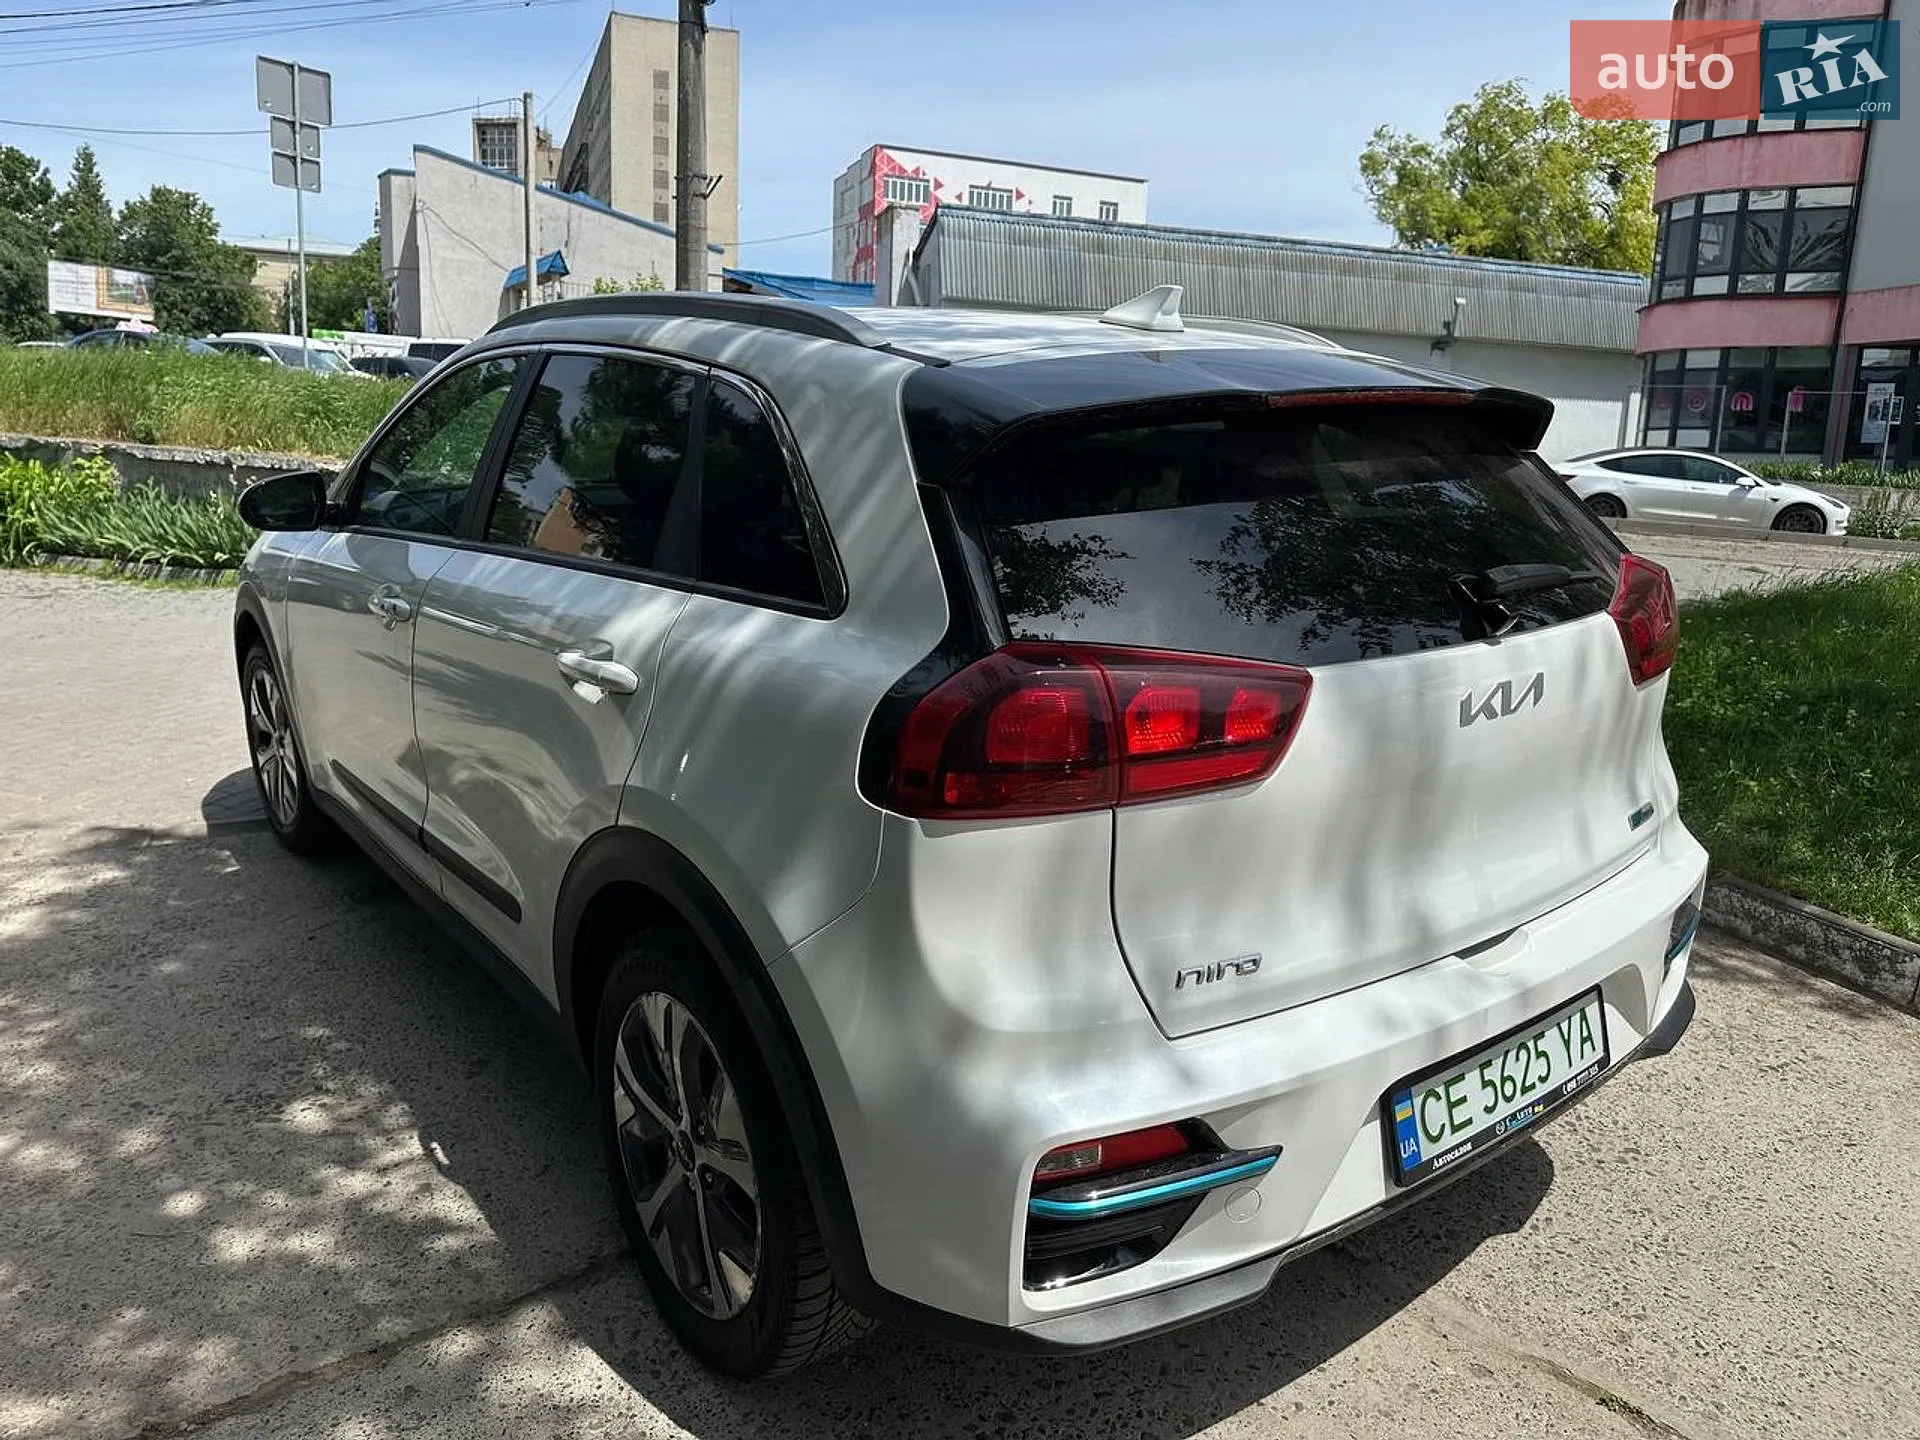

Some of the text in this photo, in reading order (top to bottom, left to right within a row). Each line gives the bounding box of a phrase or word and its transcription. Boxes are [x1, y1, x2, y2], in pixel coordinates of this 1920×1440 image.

[1459, 672, 1544, 728] KIA
[1420, 1073, 1473, 1144] CE
[1479, 1031, 1550, 1114] 5625
[1557, 1006, 1596, 1068] YA
[1400, 1137, 1418, 1158] UA
